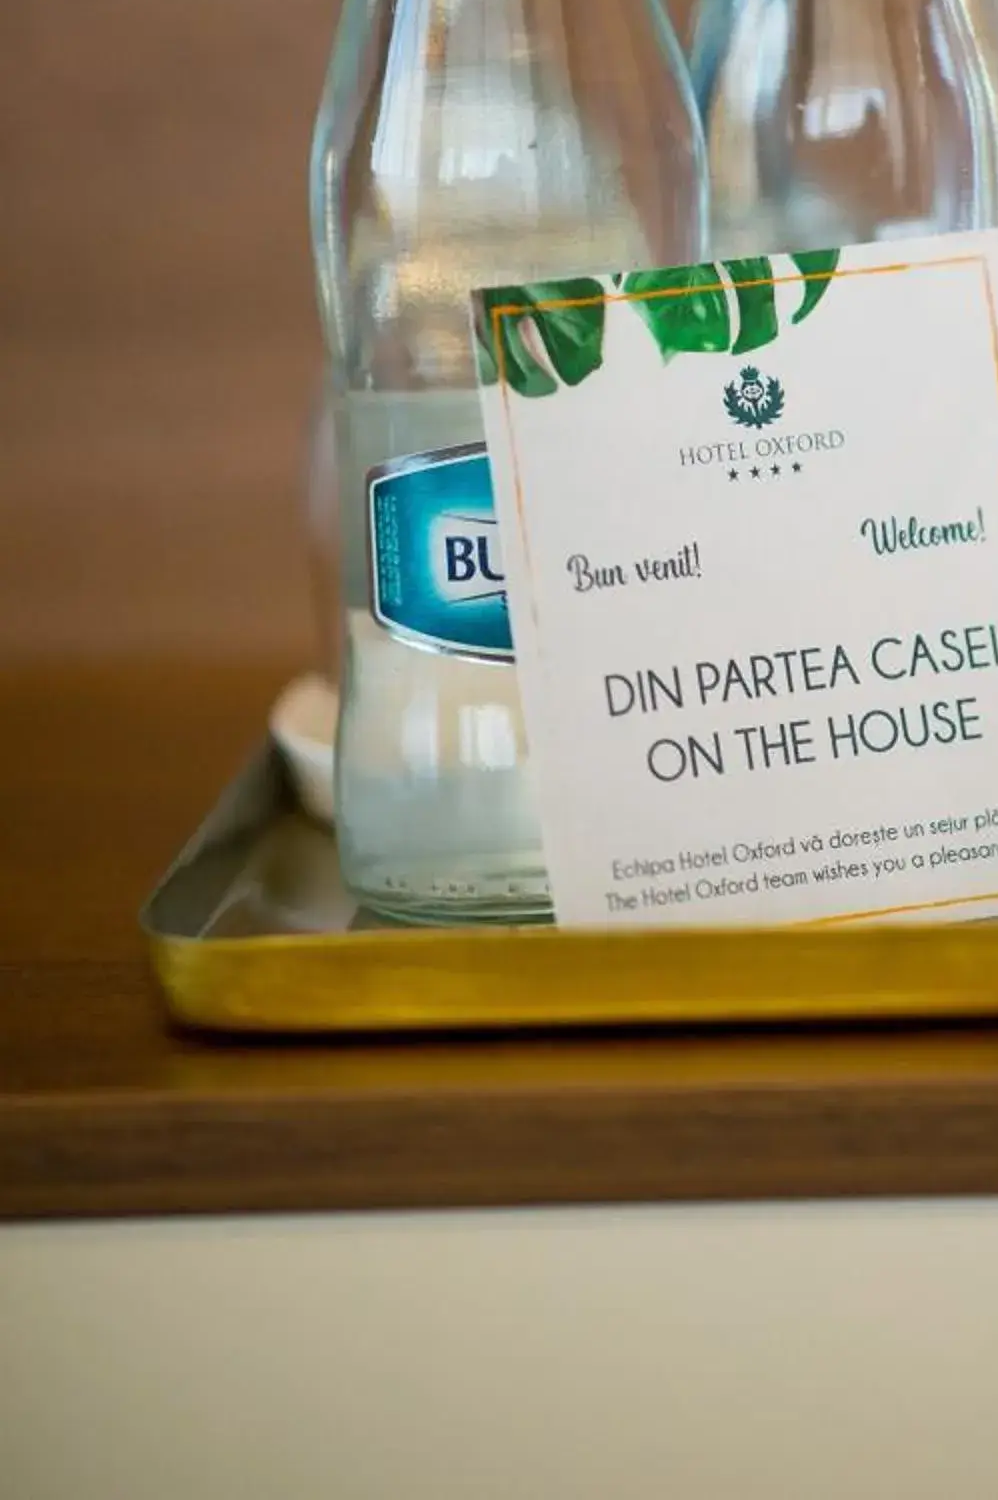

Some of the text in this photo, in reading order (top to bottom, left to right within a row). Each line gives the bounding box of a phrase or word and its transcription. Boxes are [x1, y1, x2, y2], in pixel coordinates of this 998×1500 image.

[679, 430, 846, 468] HOTEL OXFORD
[860, 506, 988, 557] Welcome!
[566, 540, 703, 594] Bun venit!
[604, 665, 685, 718] DIN
[695, 643, 861, 706] PARTEA
[646, 697, 984, 783] ON THE HOUSE
[611, 856, 676, 881] Echipa
[679, 845, 729, 871] Hotel
[732, 836, 796, 864] Oxford
[903, 821, 925, 839] un
[929, 815, 969, 836] sejur
[605, 891, 639, 912] The
[641, 882, 692, 906] Hotel
[695, 872, 760, 900] Oxford
[763, 869, 809, 890] team
[813, 859, 869, 882] wishes
[872, 856, 907, 879] you
[911, 853, 925, 869] a
